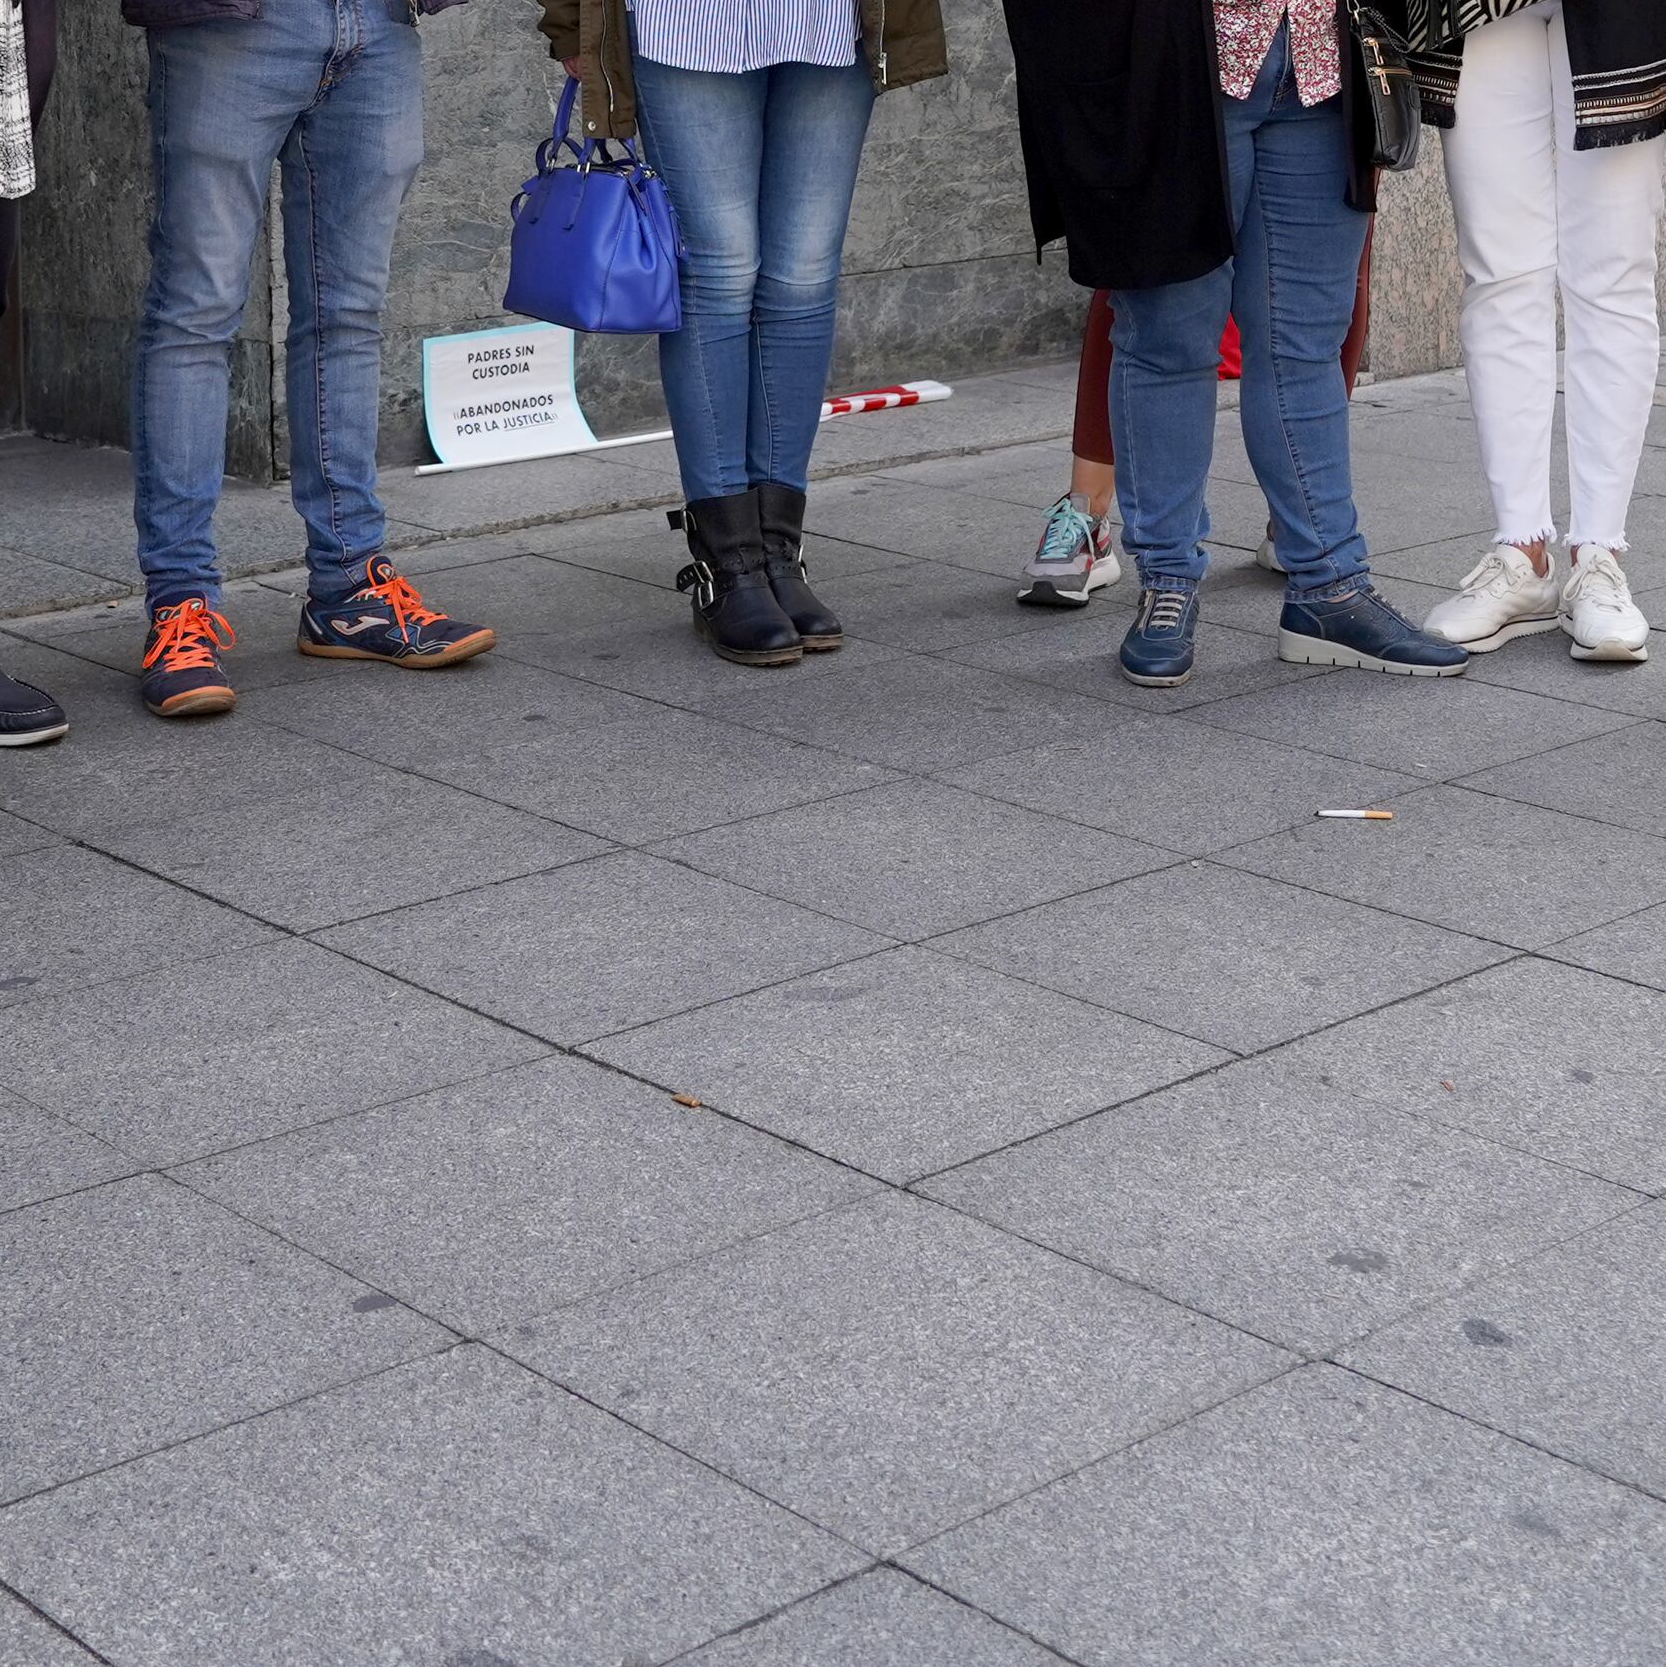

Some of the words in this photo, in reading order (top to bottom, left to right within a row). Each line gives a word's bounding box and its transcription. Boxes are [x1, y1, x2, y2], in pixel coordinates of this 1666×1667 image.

[468, 348, 511, 364] PADRES
[515, 345, 534, 357] SIN
[472, 362, 530, 380] CUSTODIA
[457, 423, 482, 436] POR
[484, 420, 500, 431] LA
